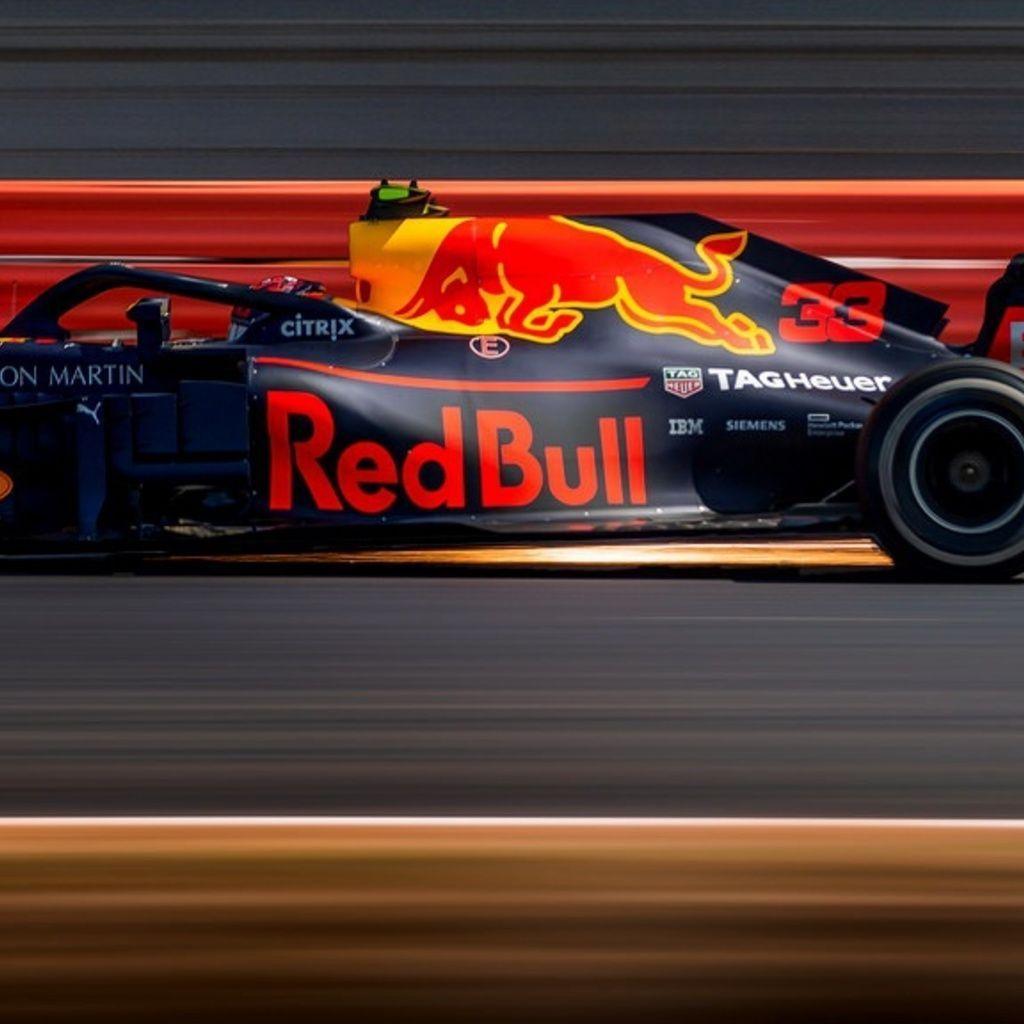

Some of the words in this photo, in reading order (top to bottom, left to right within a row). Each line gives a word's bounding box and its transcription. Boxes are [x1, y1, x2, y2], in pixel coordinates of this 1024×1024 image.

[778, 281, 887, 343] 33
[0, 365, 37, 387] ON
[49, 364, 144, 386] MARTIN
[668, 369, 698, 378] TAG
[668, 418, 704, 435] IBM
[726, 420, 787, 432] SIEMENS
[267, 390, 466, 513] Red
[476, 410, 647, 508] Bull
